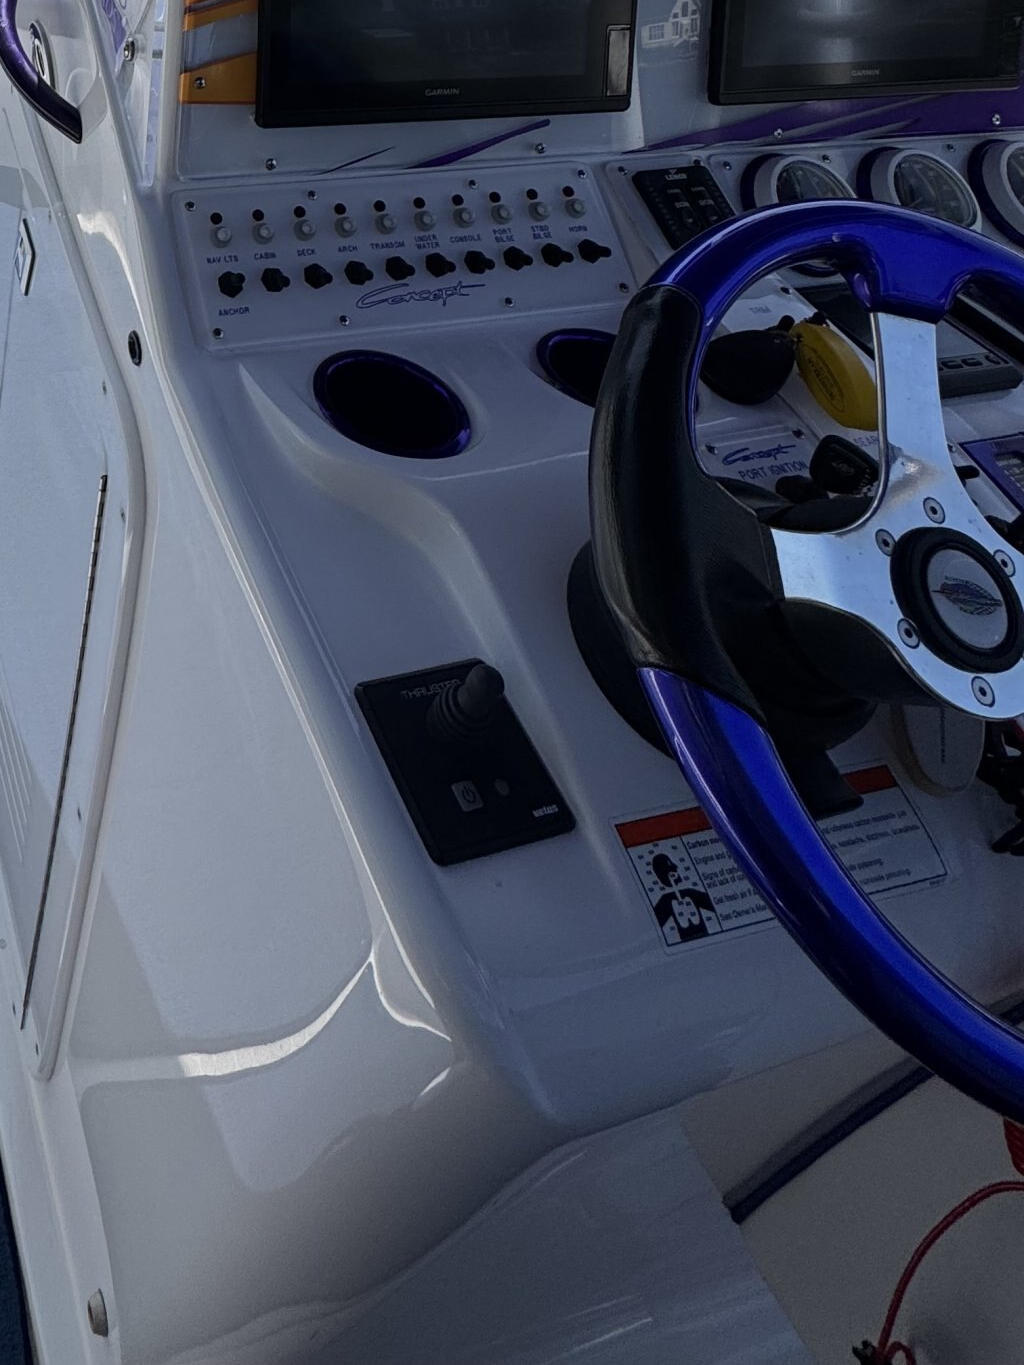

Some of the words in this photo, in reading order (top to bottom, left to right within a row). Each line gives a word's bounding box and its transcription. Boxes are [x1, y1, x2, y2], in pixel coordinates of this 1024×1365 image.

[425, 88, 460, 96] GARMIN
[492, 227, 512, 235] PORT
[568, 225, 588, 233] HORN
[414, 234, 438, 242] UNDER
[449, 234, 482, 243] CONSOLE
[338, 245, 358, 253] ARCH
[369, 240, 406, 250] TRANSOM
[416, 242, 440, 250] WATER
[254, 252, 276, 260] CABIN
[296, 248, 317, 257] DECK
[206, 256, 222, 264] NAV
[224, 254, 239, 263] LTS
[218, 306, 250, 316] ANCHOR
[738, 466, 769, 481] PORT
[769, 458, 809, 476] IGNITION
